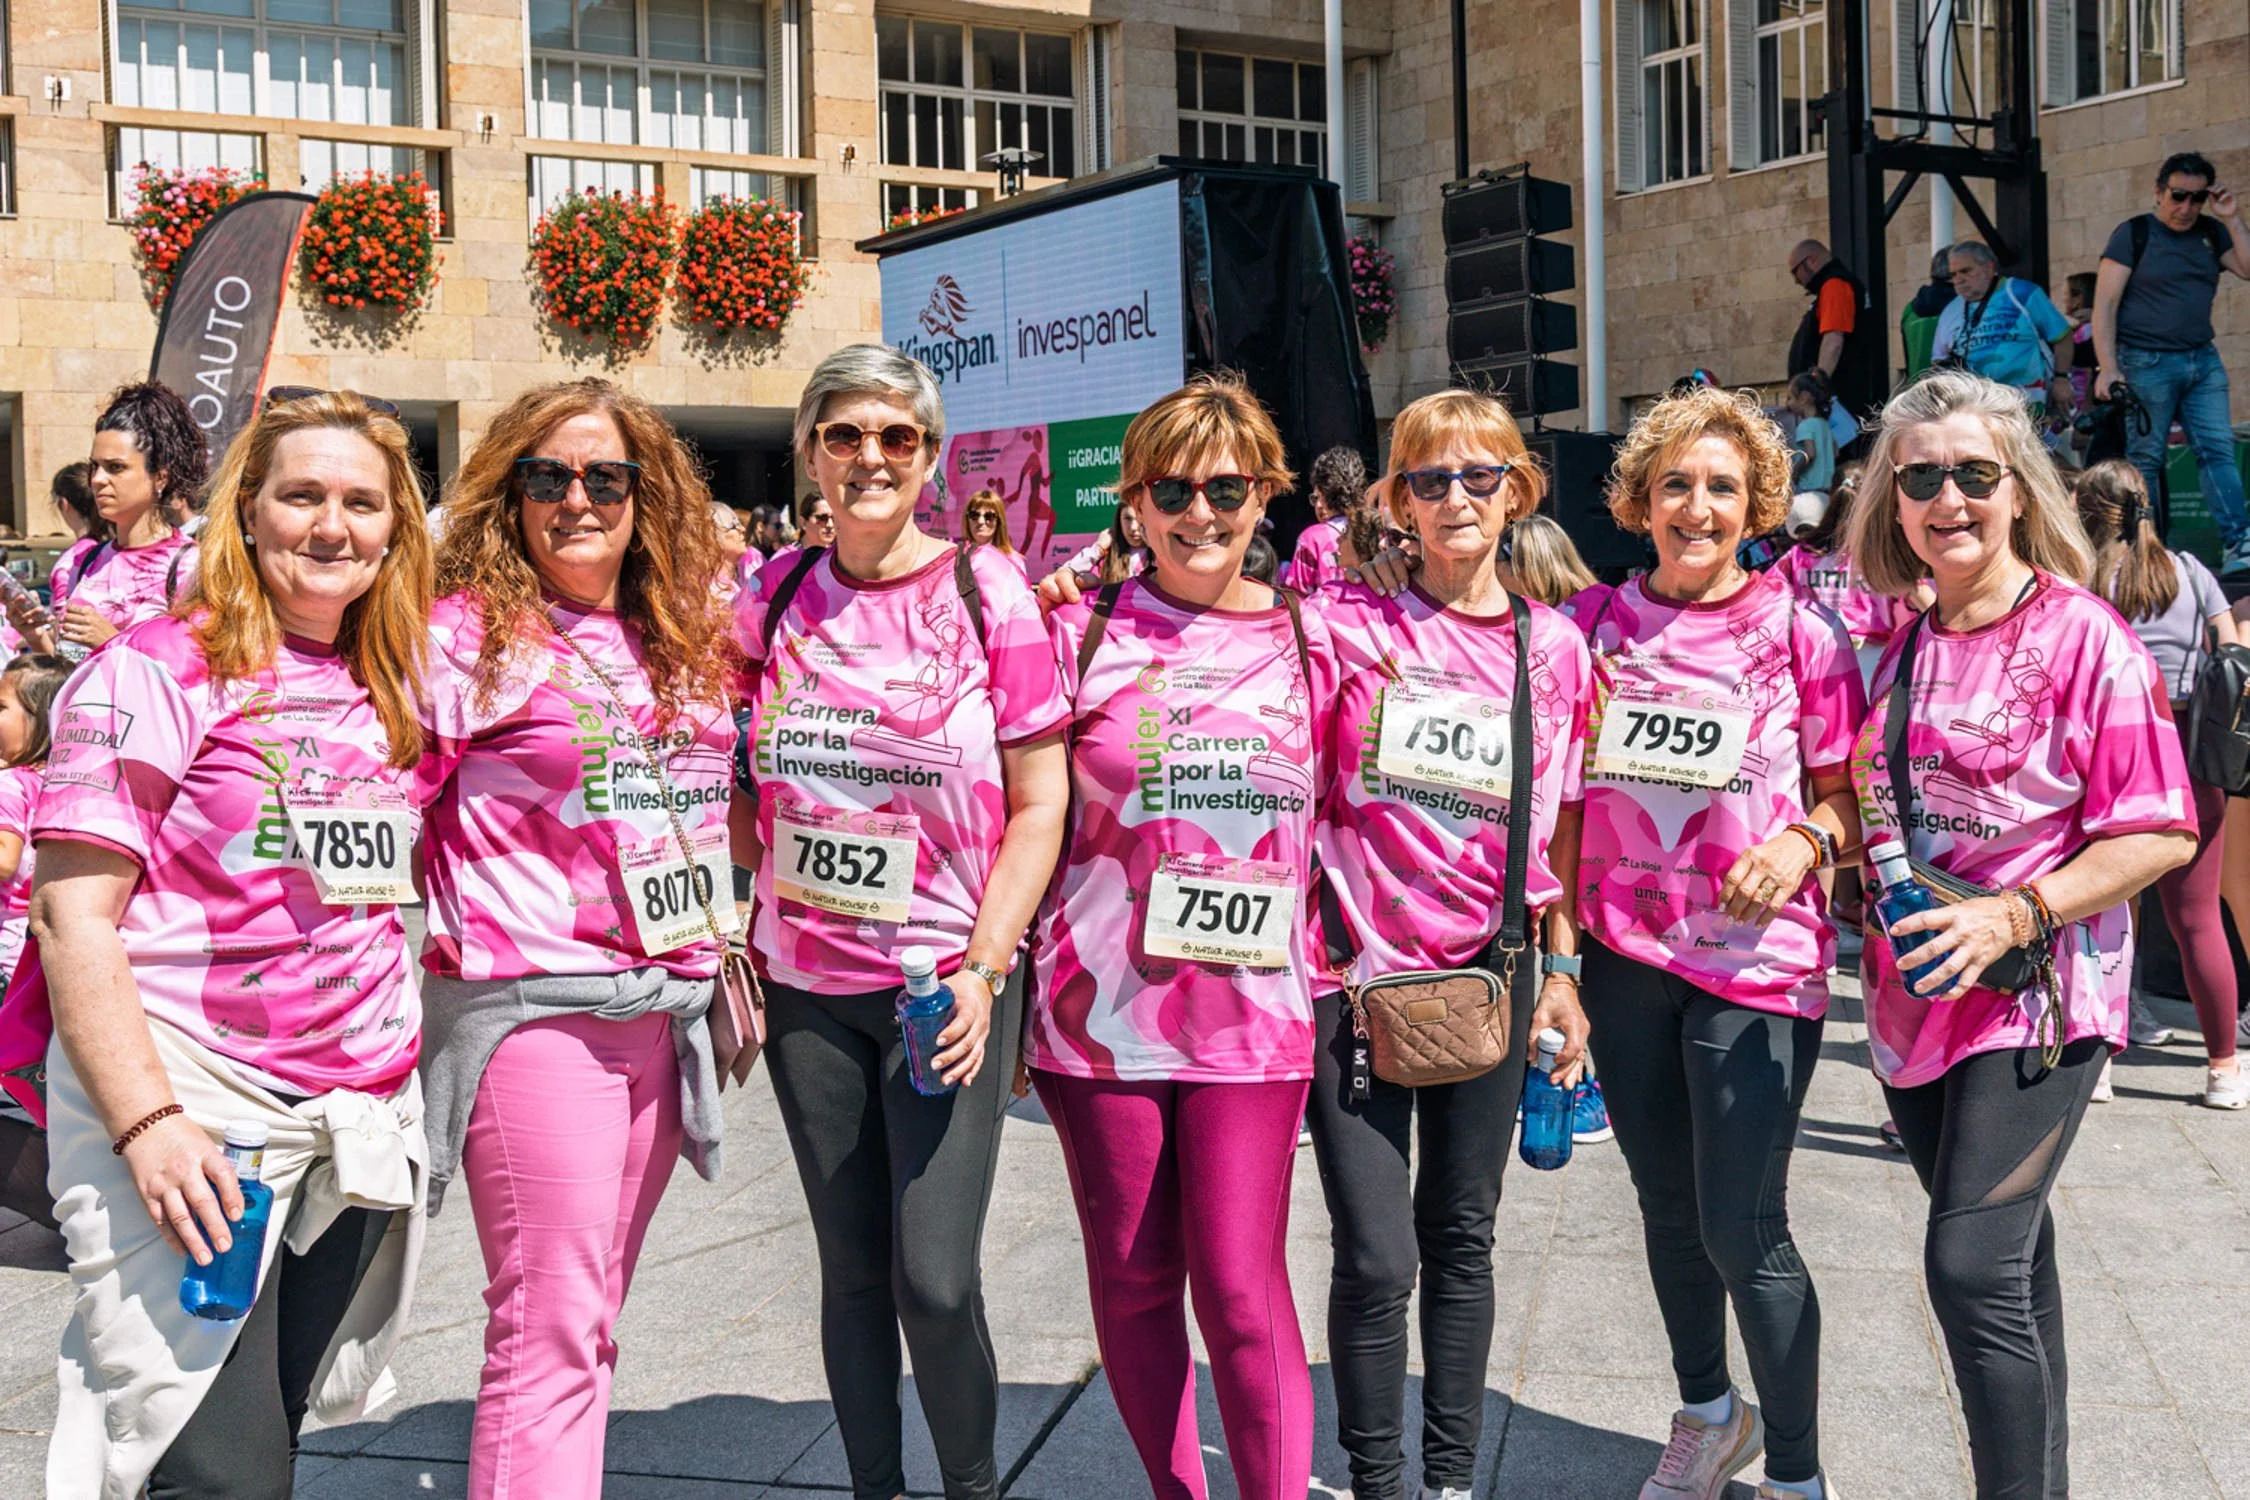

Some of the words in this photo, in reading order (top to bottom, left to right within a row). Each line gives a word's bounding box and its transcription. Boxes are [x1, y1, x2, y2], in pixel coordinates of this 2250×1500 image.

[1017, 289, 1158, 364] invespanel
[189, 275, 252, 429] OAUTO
[1067, 446, 1122, 468] ¡¡GRACIA
[1075, 486, 1120, 508] PARTIC
[796, 672, 820, 692] XI
[598, 700, 625, 718] XI
[754, 664, 796, 774] mujer
[786, 697, 877, 725] Carrera
[1168, 707, 1191, 725] XI
[288, 736, 320, 758] XI
[776, 728, 817, 751] por
[823, 729, 847, 752] la
[1168, 733, 1267, 751] Carrera
[1623, 710, 1722, 757] 7959
[569, 699, 615, 812] mujer
[1129, 706, 1169, 812] mujer
[776, 753, 942, 788] Investigación
[1169, 763, 1213, 786] por
[1219, 759, 1243, 781] la
[1425, 767, 1455, 779] NATUR
[1637, 763, 1667, 774] NATUR
[1668, 767, 1698, 778] HOUSE
[1851, 722, 1884, 826] mujer
[1171, 788, 1304, 816] Investigació
[1873, 784, 1895, 804] po
[304, 820, 396, 869] 7850
[793, 833, 888, 889] 7852
[1630, 859, 1641, 868] La
[1641, 861, 1662, 873] Rioja
[642, 863, 714, 922] 8070
[1176, 886, 1272, 936] 7507
[314, 944, 328, 955] La
[1192, 946, 1223, 956] NATUR
[1224, 949, 1253, 960] HOUSE
